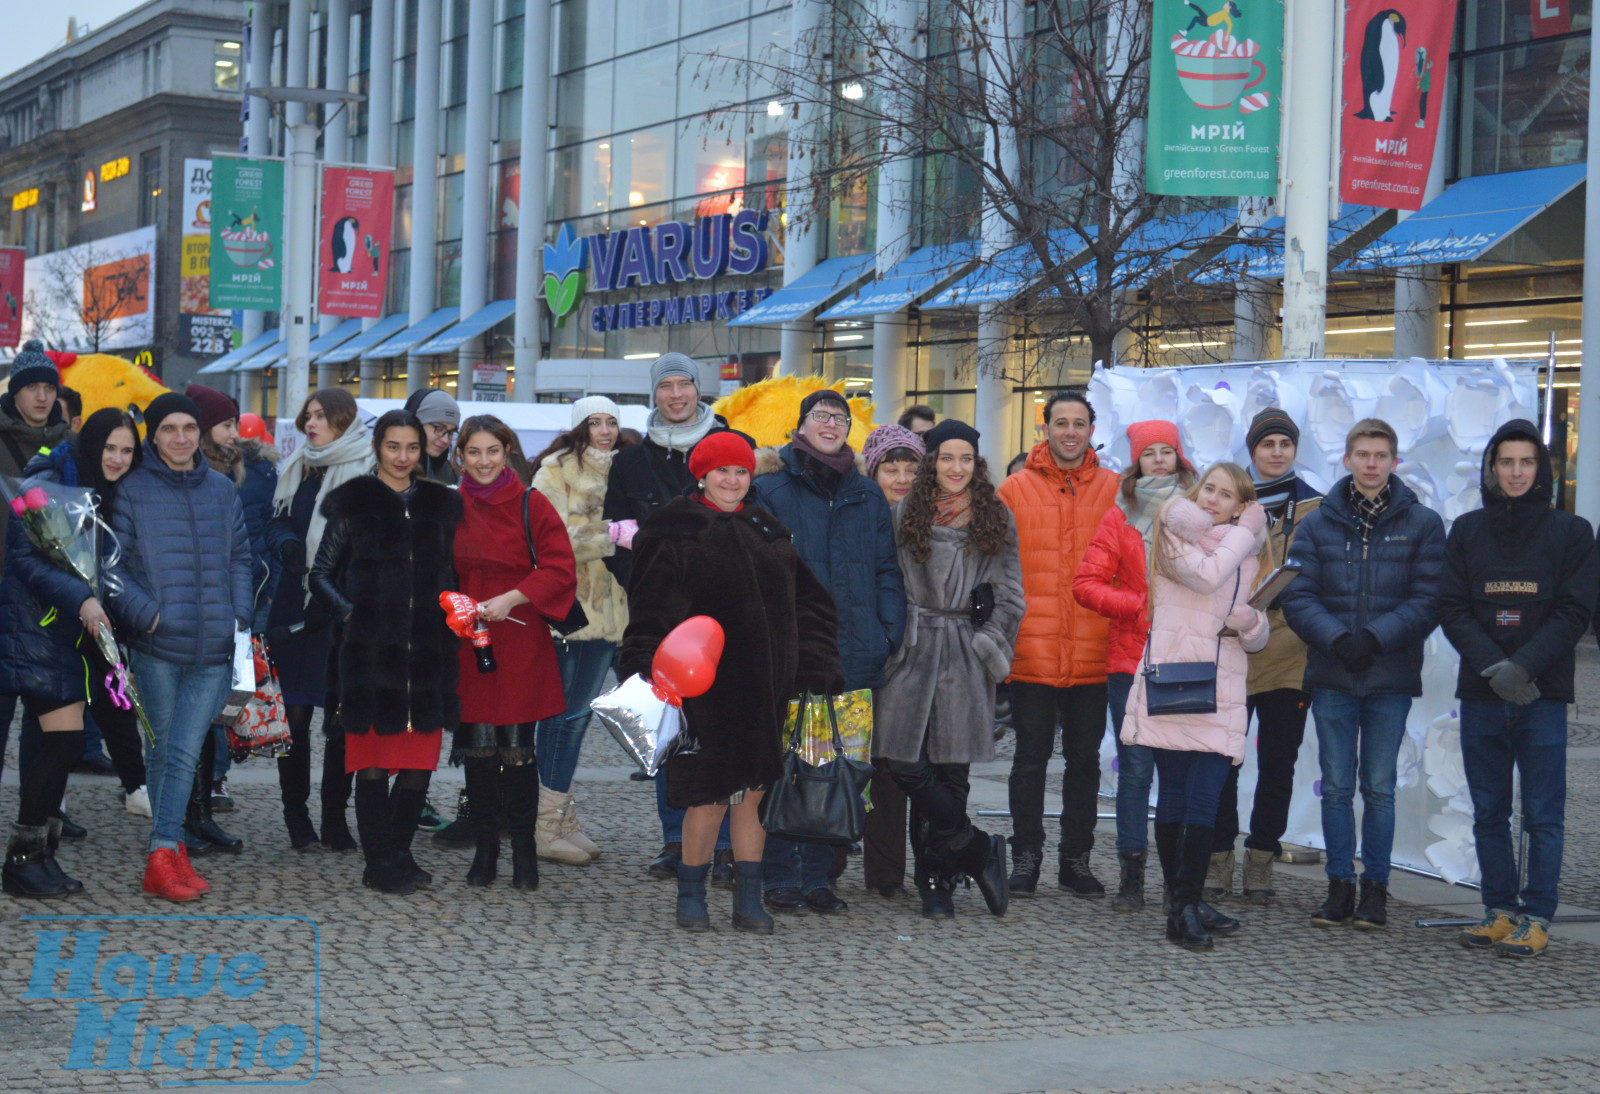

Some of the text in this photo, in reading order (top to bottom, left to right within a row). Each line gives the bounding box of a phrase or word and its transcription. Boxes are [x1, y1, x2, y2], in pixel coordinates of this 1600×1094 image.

[1191, 121, 1245, 140] МРІЙ
[1219, 144, 1243, 153] Green
[1245, 144, 1269, 153] Forest
[1375, 137, 1408, 156] МРІЙ
[1164, 168, 1270, 180] greenforest.com.ua
[345, 188, 373, 196] FOREST
[1351, 179, 1420, 195] greenforest.com.ua
[588, 208, 769, 290] VARUS
[232, 272, 261, 283] МРІЙ
[341, 280, 368, 291] МРІЙ
[591, 288, 774, 332] СУПЕРМАРКЕТ
[449, 592, 466, 614] LOVE
[460, 594, 476, 617] YOU
